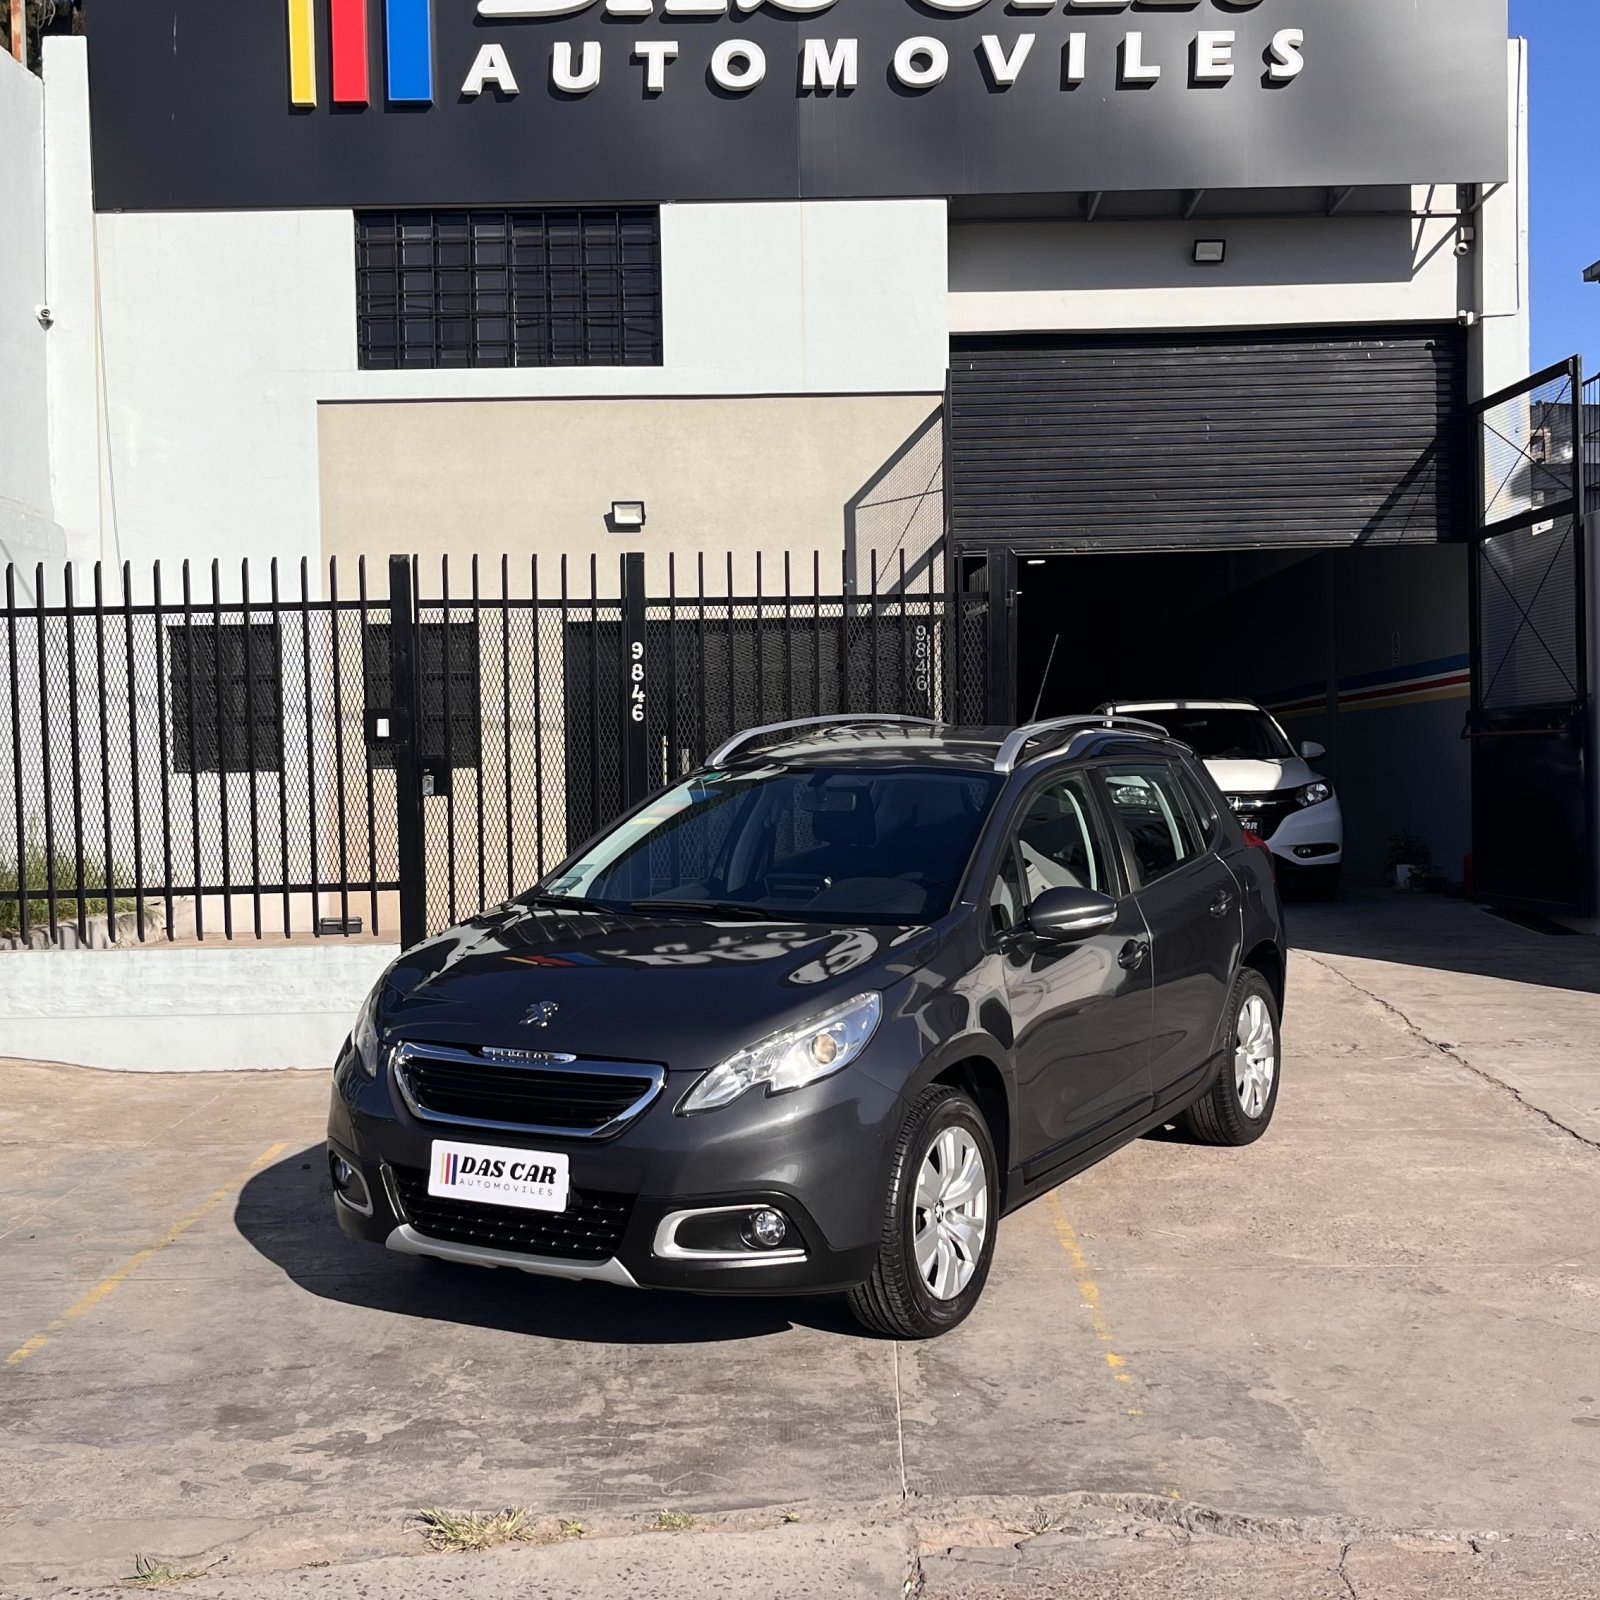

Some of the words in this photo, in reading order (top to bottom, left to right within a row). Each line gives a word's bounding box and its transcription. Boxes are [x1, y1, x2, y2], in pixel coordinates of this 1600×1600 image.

[461, 29, 1304, 96] AUTOMOVILES
[631, 641, 646, 721] 9846
[915, 625, 928, 691] 9846
[459, 1156, 506, 1178] DAS
[509, 1162, 557, 1185] CAR
[459, 1178, 553, 1197] AUTOMOVILES
